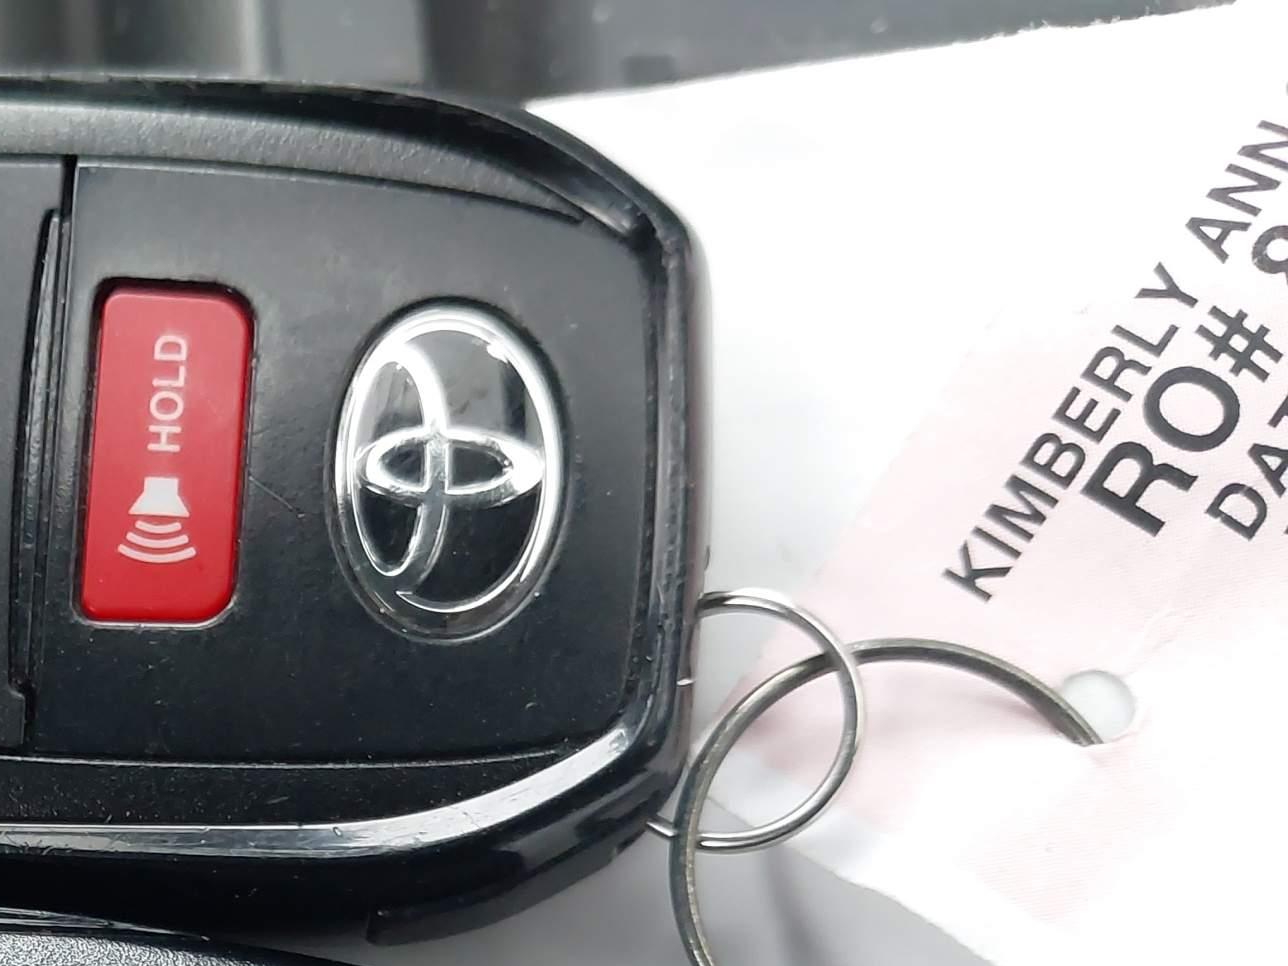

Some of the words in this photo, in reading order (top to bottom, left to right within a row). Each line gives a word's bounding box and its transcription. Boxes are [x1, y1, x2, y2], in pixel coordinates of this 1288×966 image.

[147, 333, 188, 453] HOLD
[944, 263, 1199, 601] KIMBERLY
[1081, 306, 1283, 536] RO#
